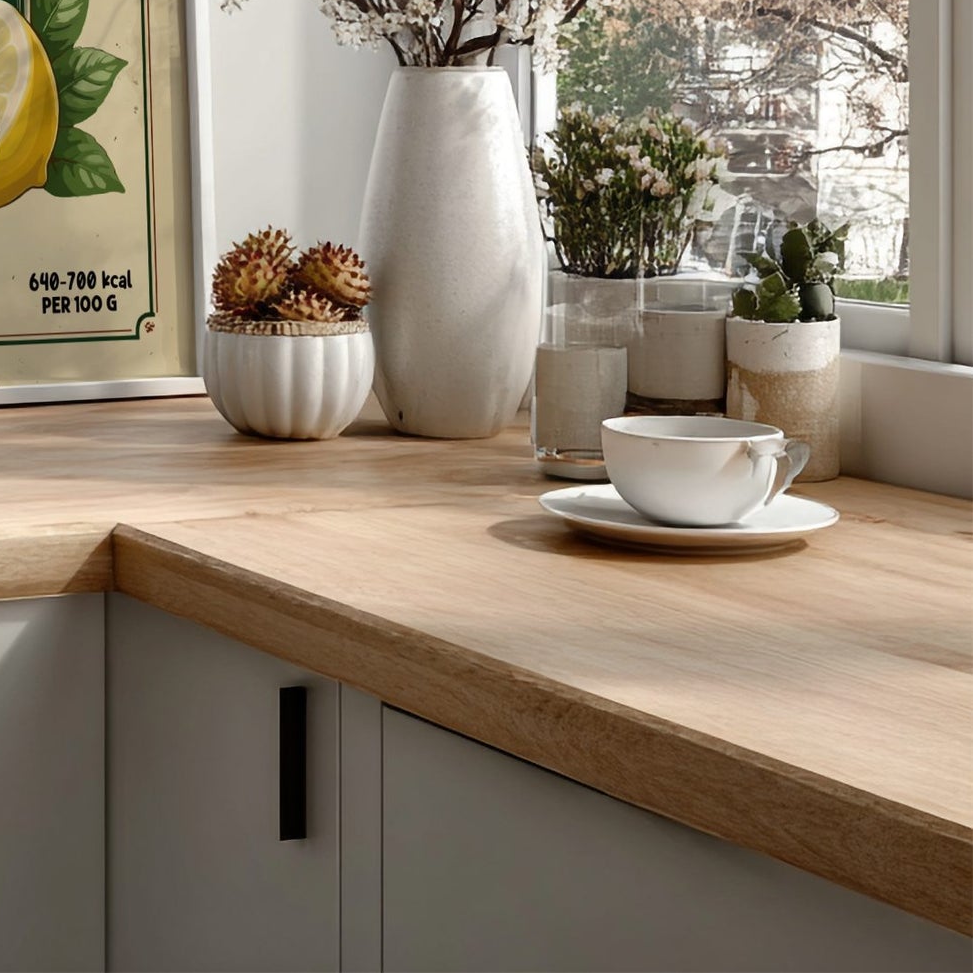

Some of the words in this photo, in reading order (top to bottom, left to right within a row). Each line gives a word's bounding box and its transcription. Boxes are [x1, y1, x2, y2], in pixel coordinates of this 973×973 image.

[29, 270, 97, 292] 640-700
[102, 269, 133, 290] kcal
[42, 296, 71, 314] PER
[74, 294, 103, 313] 100
[106, 294, 118, 312] G
